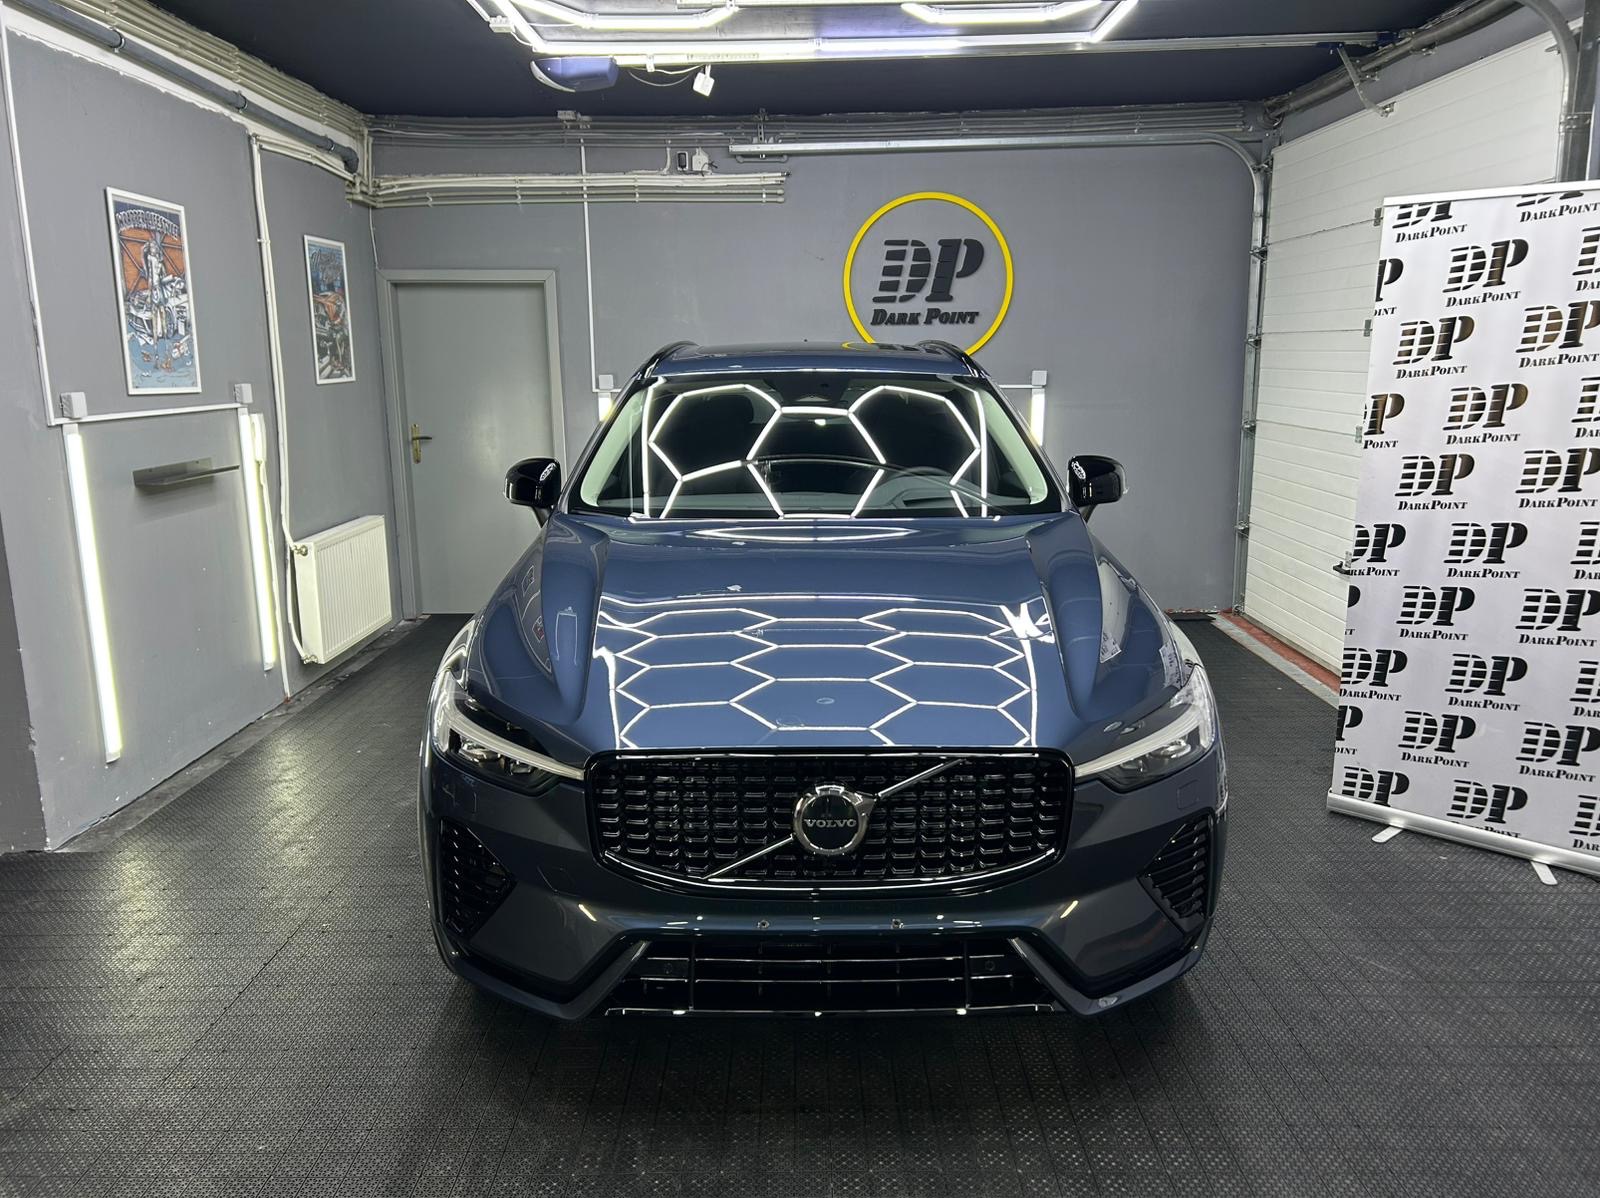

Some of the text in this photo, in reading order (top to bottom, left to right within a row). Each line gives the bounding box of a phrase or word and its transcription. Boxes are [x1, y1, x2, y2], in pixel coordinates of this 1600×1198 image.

[872, 238, 985, 303] DP
[1442, 238, 1529, 293] DP
[870, 308, 979, 325] DARK POINT
[1515, 300, 1600, 353] DP
[1393, 315, 1475, 365] DP
[1442, 383, 1529, 431] DP
[1394, 453, 1475, 497] DP
[1515, 448, 1600, 493] DP
[1443, 522, 1528, 564] DP
[1395, 586, 1475, 627] DP
[1515, 588, 1600, 632] DP
[1340, 648, 1408, 687] DP
[1444, 654, 1528, 696] DP
[1397, 710, 1477, 753] DP
[1515, 721, 1600, 767] DP
[1342, 766, 1410, 807] DP
[1446, 779, 1528, 824] DP
[803, 818, 857, 828] VOLVO
